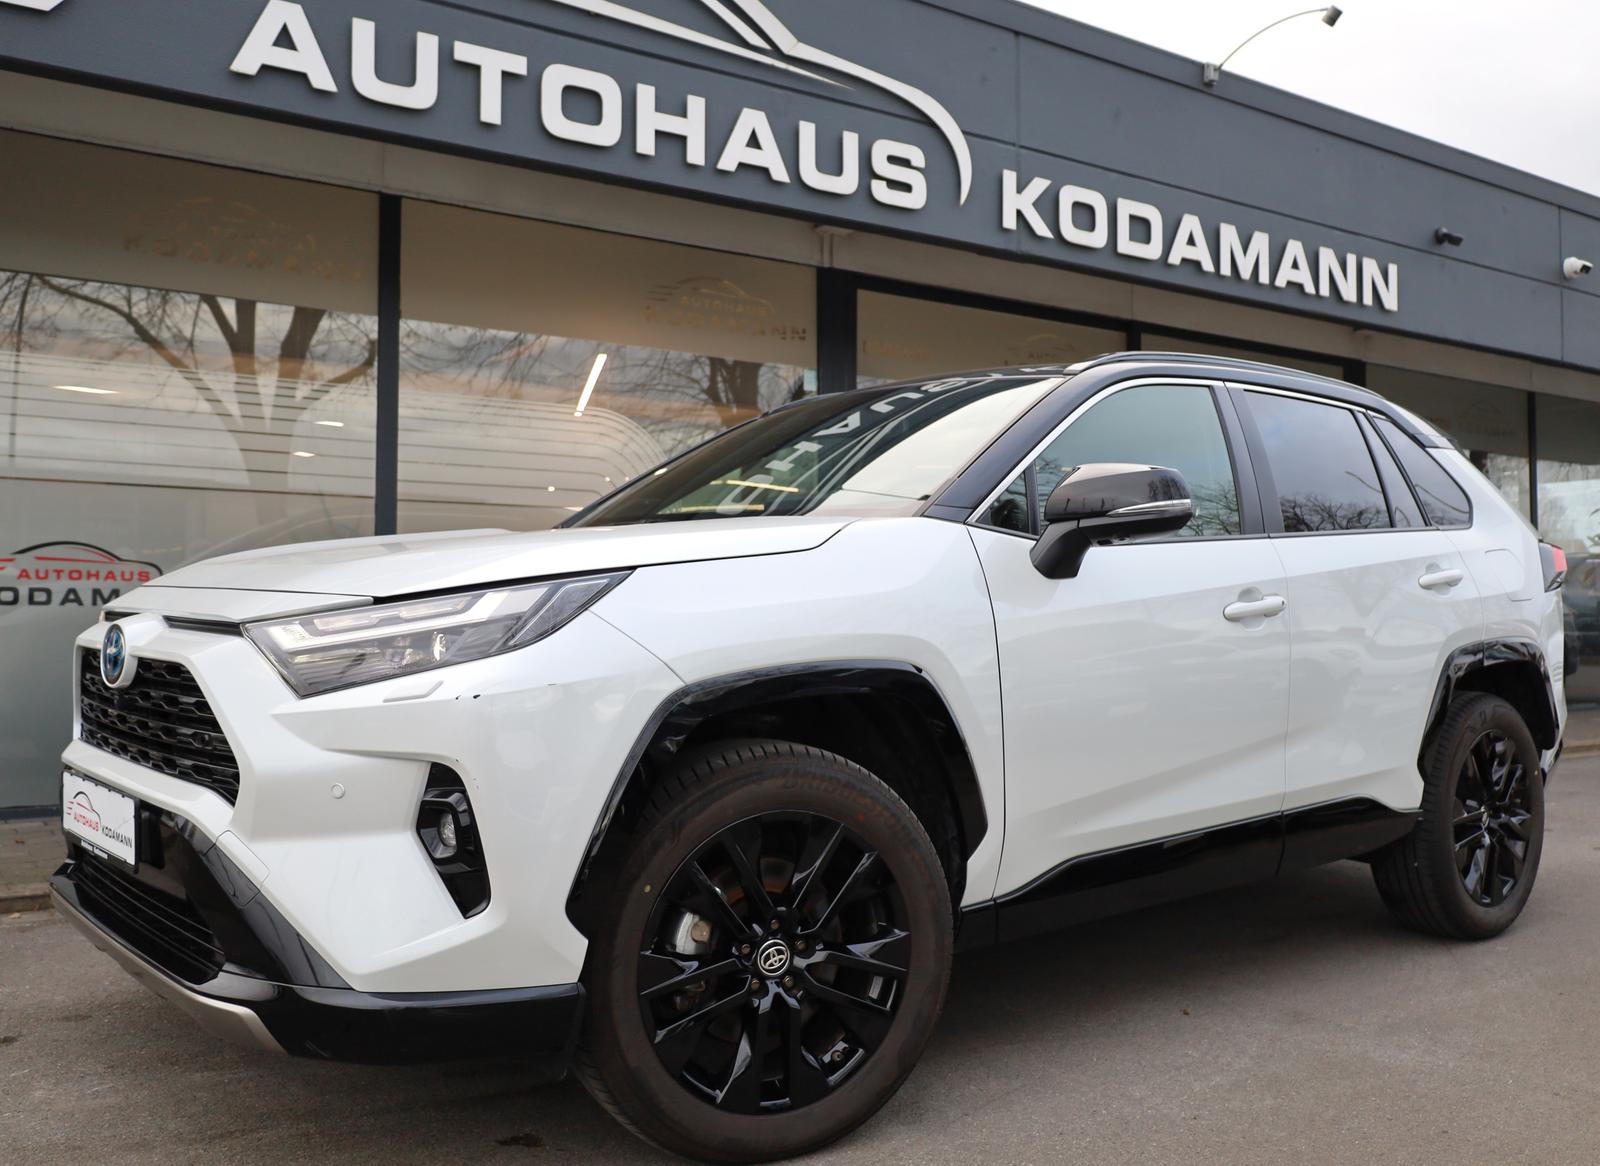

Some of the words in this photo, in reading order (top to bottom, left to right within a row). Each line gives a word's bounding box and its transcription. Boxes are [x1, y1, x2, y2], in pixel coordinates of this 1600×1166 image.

[229, 0, 928, 210] AUTOHAUS
[1001, 168, 1399, 312] KODAMANN
[16, 568, 152, 583] AUTOHAUS
